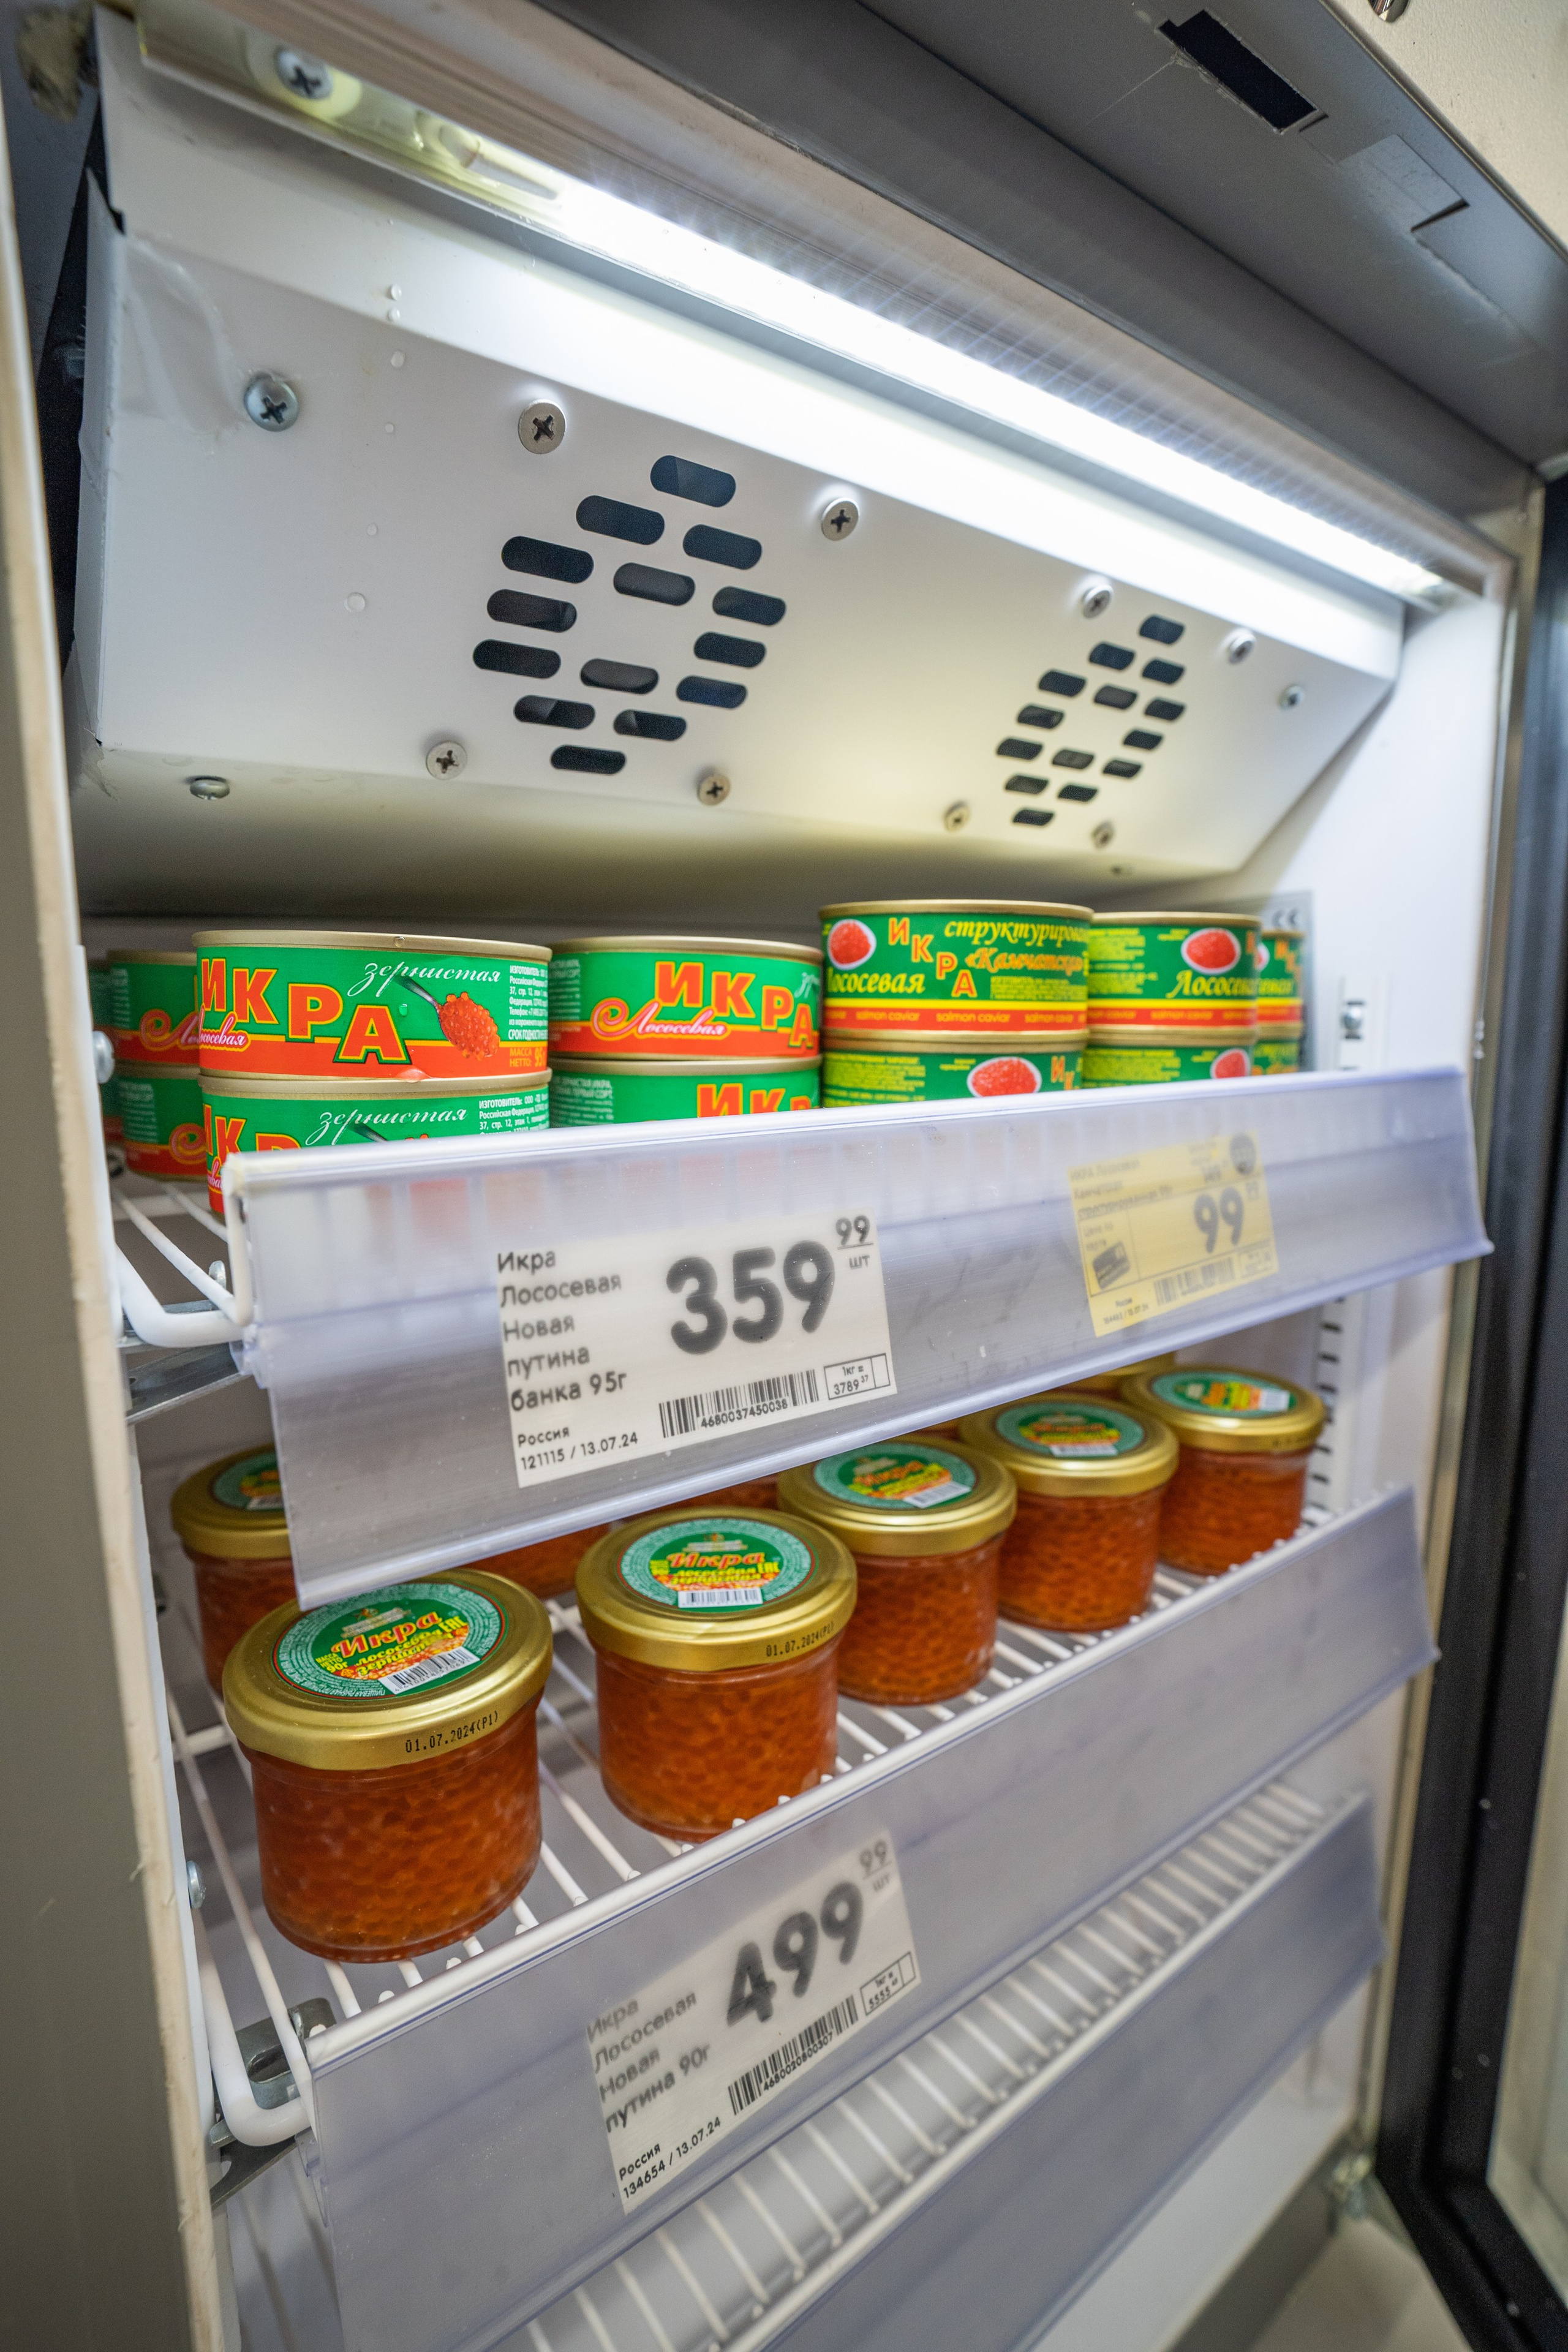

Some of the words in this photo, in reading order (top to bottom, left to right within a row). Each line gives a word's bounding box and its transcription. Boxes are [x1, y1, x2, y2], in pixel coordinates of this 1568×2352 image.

[888, 917, 978, 998] ИКРА
[347, 961, 502, 997] зернистая
[201, 958, 413, 1065] ИКРА
[591, 997, 730, 1041] Лососевая
[655, 961, 813, 1047] ИКРА
[510, 1048, 532, 1057] МАССА
[510, 1058, 532, 1067] НЕТТО:
[479, 1097, 522, 1109] ИЗГОТОВИТЕЛЬ:
[306, 1110, 468, 1146] зернистая
[480, 1121, 489, 1130] 37,
[835, 1215, 870, 1246] 99
[498, 1250, 556, 1273] Икра
[850, 1254, 870, 1269] шт
[500, 1273, 622, 1308] Лососевая
[666, 1240, 835, 1355] 359
[503, 1314, 575, 1341] Новая
[508, 1346, 590, 1380] путина
[842, 1366, 855, 1376] 1кг
[511, 1388, 581, 1412] банка
[589, 1371, 627, 1395] 95г
[834, 1379, 859, 1395] 3789
[701, 1398, 788, 1428] 4680037450038
[518, 1426, 570, 1448] Россия
[521, 1449, 565, 1470] 121115
[581, 1431, 638, 1457] 13.07.24
[666, 1552, 765, 1570] Икра
[331, 1610, 442, 1659] Икра
[859, 1841, 888, 1872] 99
[726, 1882, 864, 2027] 499
[586, 1998, 639, 2045] Икра
[594, 1992, 696, 2074] Лососевая
[599, 2048, 661, 2104] Новая
[764, 2032, 833, 2091] 4680020800307
[605, 2073, 676, 2133] путина
[679, 2044, 712, 2076] 90г
[619, 2144, 662, 2180] Россия
[624, 2160, 666, 2199] 134654
[676, 2117, 722, 2158] 13.07.24
